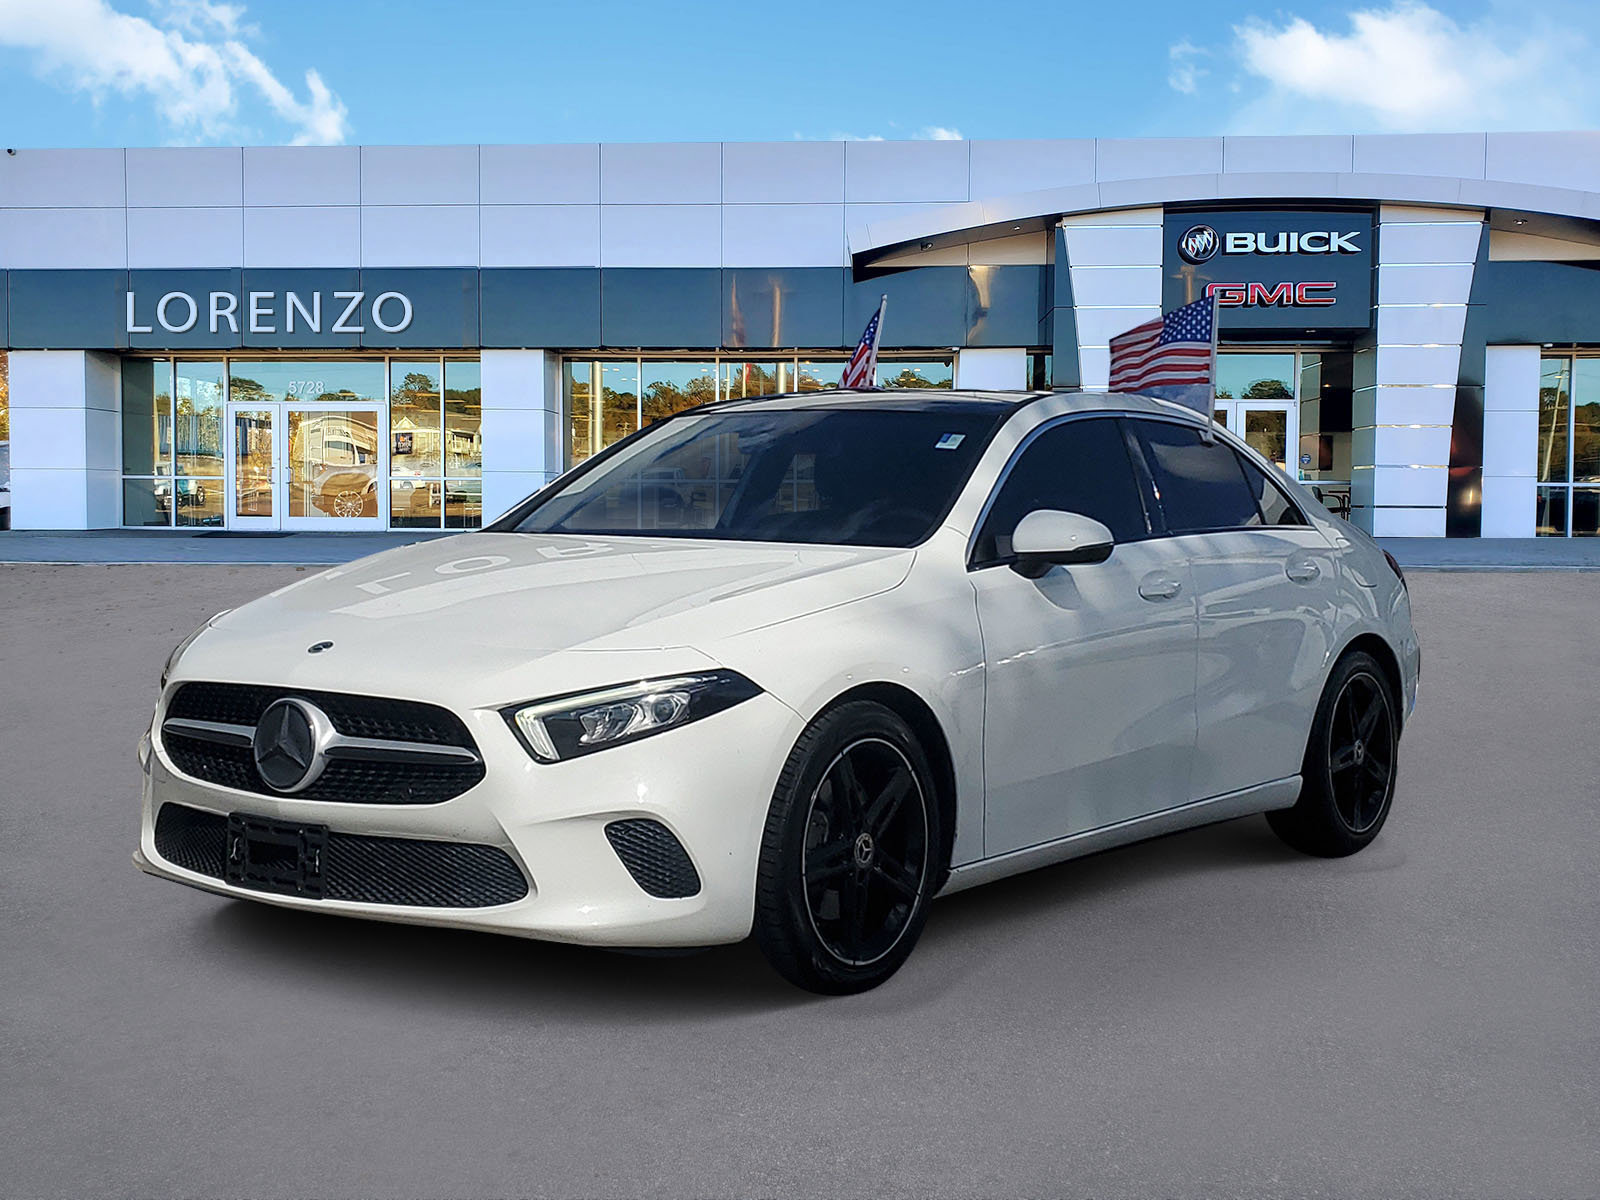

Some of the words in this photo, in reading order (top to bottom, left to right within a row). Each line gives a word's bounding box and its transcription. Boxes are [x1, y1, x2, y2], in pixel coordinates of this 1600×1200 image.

[1224, 231, 1362, 253] BUICK
[1205, 282, 1337, 305] GMC
[126, 291, 413, 333] LORENZO
[288, 381, 325, 394] 5728
